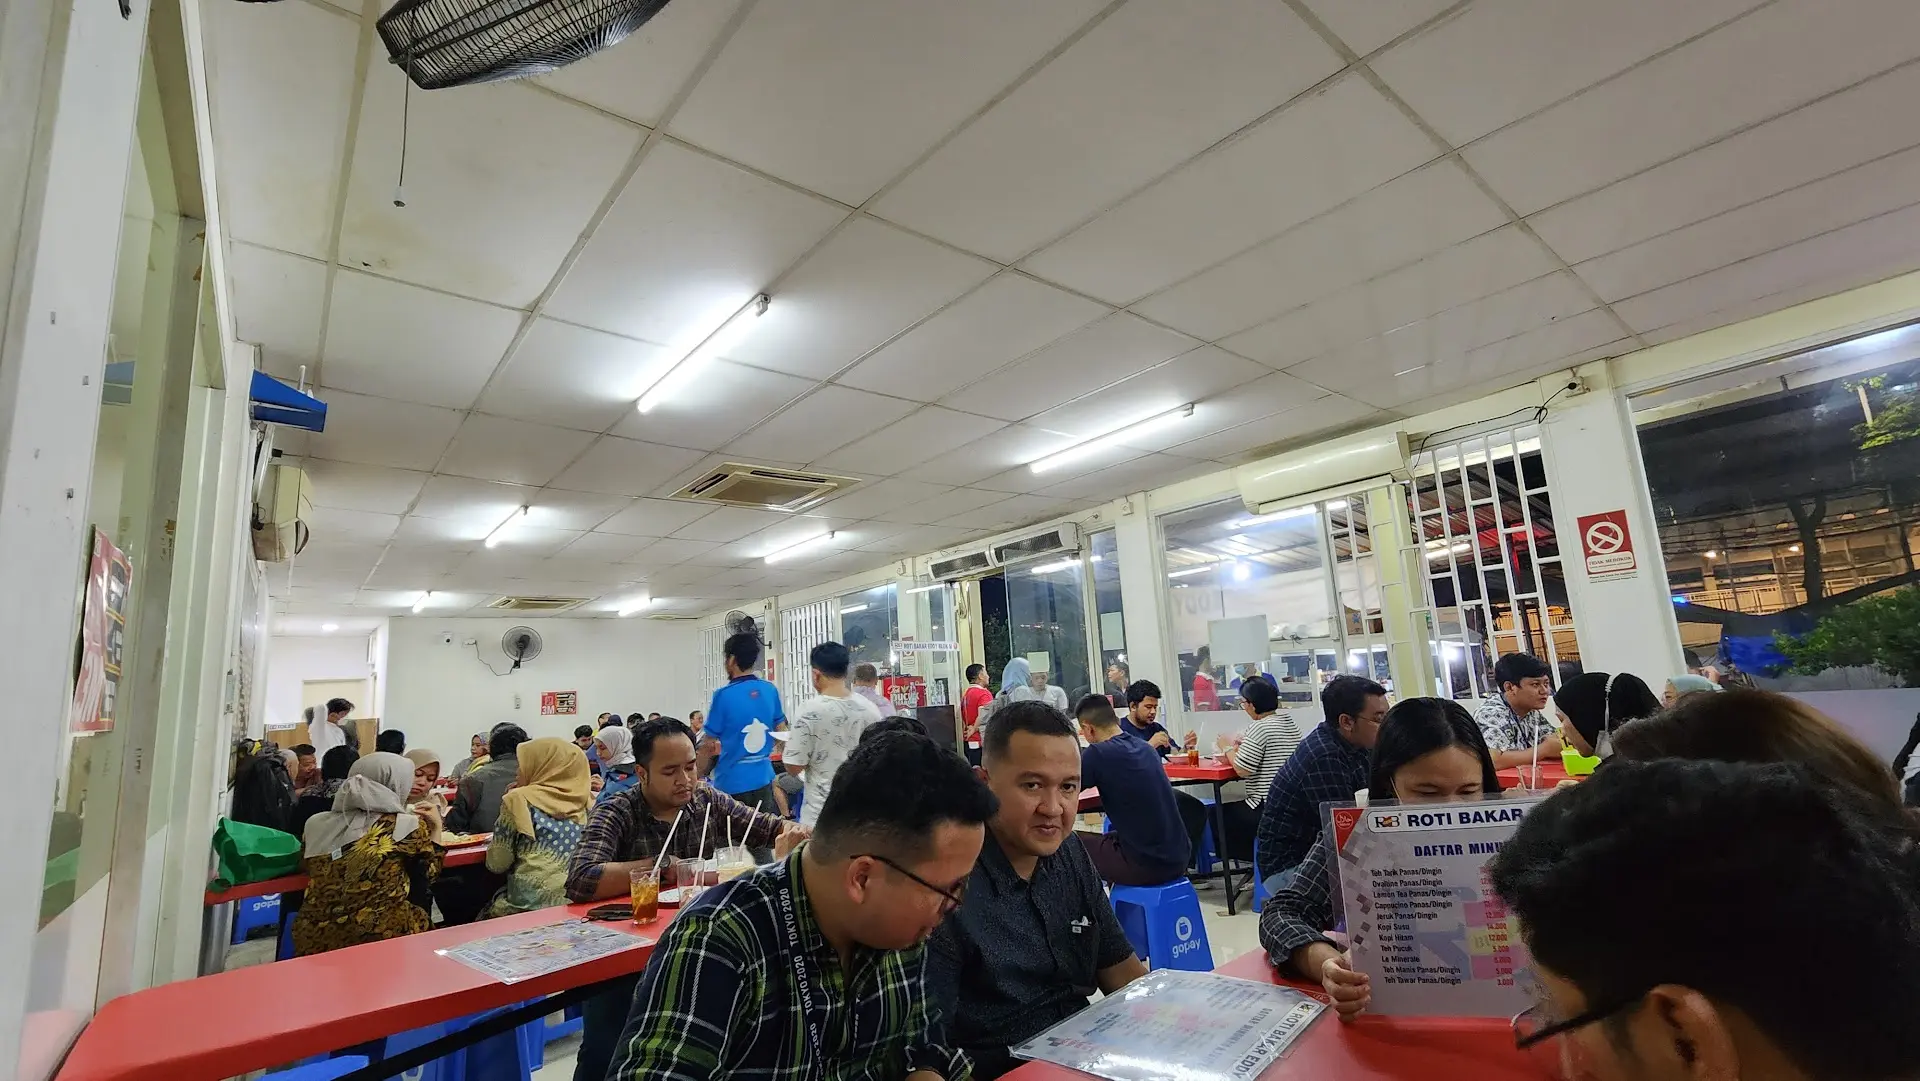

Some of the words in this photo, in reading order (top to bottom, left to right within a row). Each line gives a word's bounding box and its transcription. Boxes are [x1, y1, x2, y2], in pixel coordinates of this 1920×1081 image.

[1407, 812, 1452, 827] ROTI
[1458, 808, 1523, 824] BAKAR
[1414, 844, 1463, 857] DAFTAR
[1468, 841, 1503, 855] MINU
[1370, 868, 1382, 876] Teh
[1383, 868, 1398, 876] Tarik
[1399, 867, 1442, 876] Panas/Dingin
[1399, 878, 1443, 887] Panas/Dingin
[1373, 890, 1395, 898] Lemon
[1396, 890, 1407, 898] Tea
[1408, 889, 1452, 898] Panas/Dingin
[253, 899, 280, 911] gopa
[1409, 900, 1453, 909] Panas/Dingin
[1376, 912, 1393, 920] Jeruk
[1394, 912, 1438, 920] Panas/Dingin
[1377, 923, 1391, 932] Kopi
[1393, 923, 1410, 931] Susu
[1378, 934, 1393, 942] Kopi
[1172, 938, 1200, 958] gopay
[1381, 955, 1389, 963] Le
[1391, 955, 1420, 963] Minerale
[1416, 966, 1461, 974] Panas/Dingin
[1384, 976, 1395, 984] Teh
[1396, 976, 1416, 984] Tawar
[1417, 976, 1461, 985] Panas/Dingin
[1280, 1012, 1304, 1031] ROTI
[1252, 1029, 1286, 1056] BAKAR
[1232, 1054, 1260, 1079] EDDY
